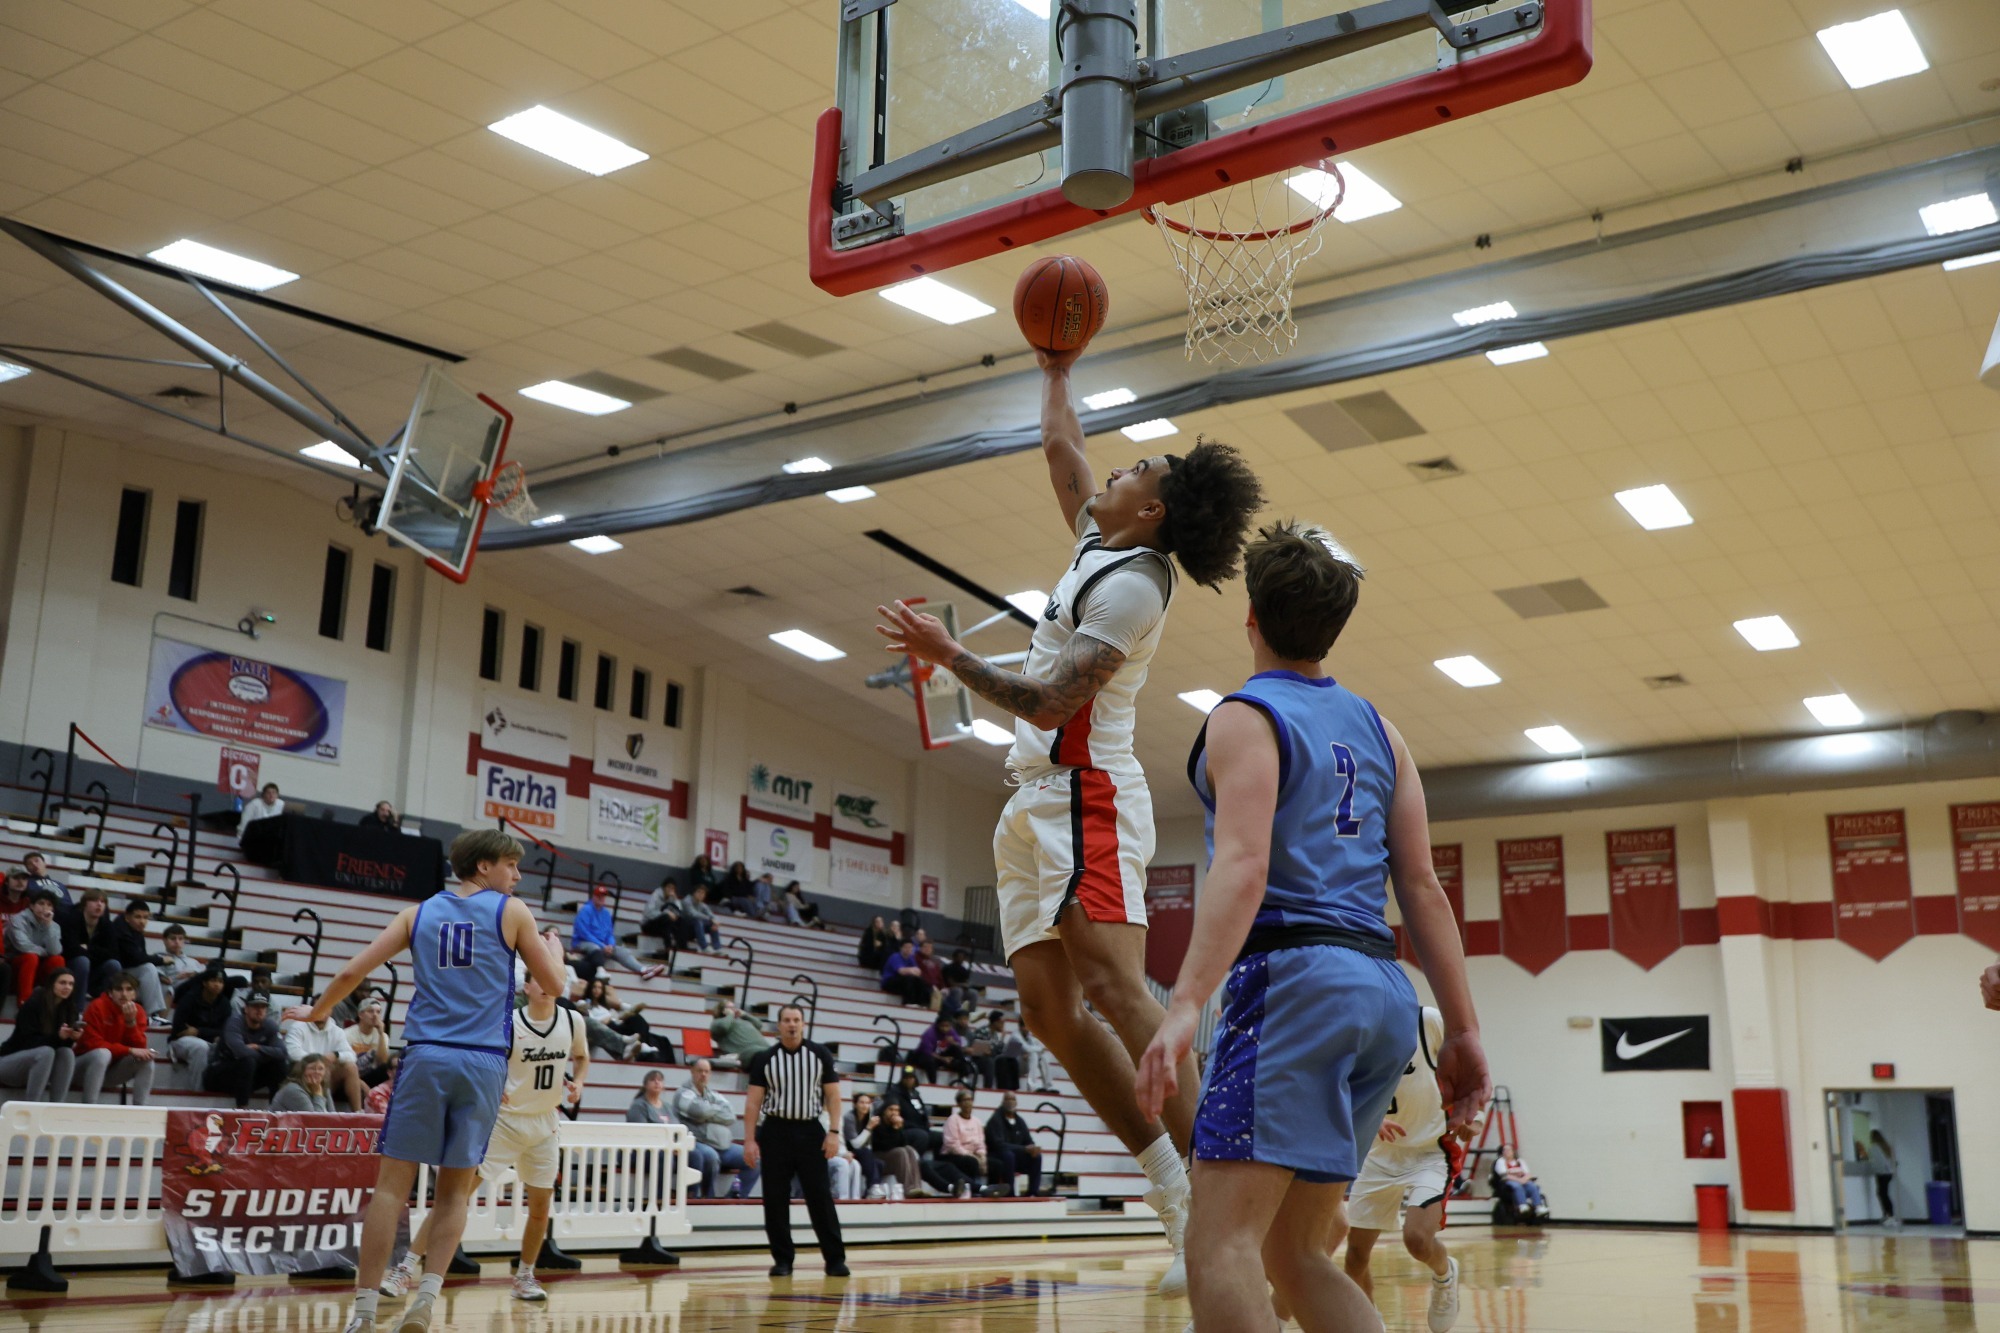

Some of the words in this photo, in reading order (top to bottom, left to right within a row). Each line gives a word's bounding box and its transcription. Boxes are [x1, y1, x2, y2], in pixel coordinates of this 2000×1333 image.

[230, 656, 271, 684] NAIA
[222, 749, 259, 763] SECTION
[229, 763, 249, 790] C
[487, 766, 557, 809] Farha
[1330, 741, 1364, 839] 2
[1834, 815, 1897, 830] FRIENDS
[337, 851, 407, 880] FRIENDS
[335, 870, 404, 891] UNIVERSITY
[438, 921, 474, 969] 10
[521, 1048, 567, 1063] Falcons
[534, 1064, 554, 1090] 10
